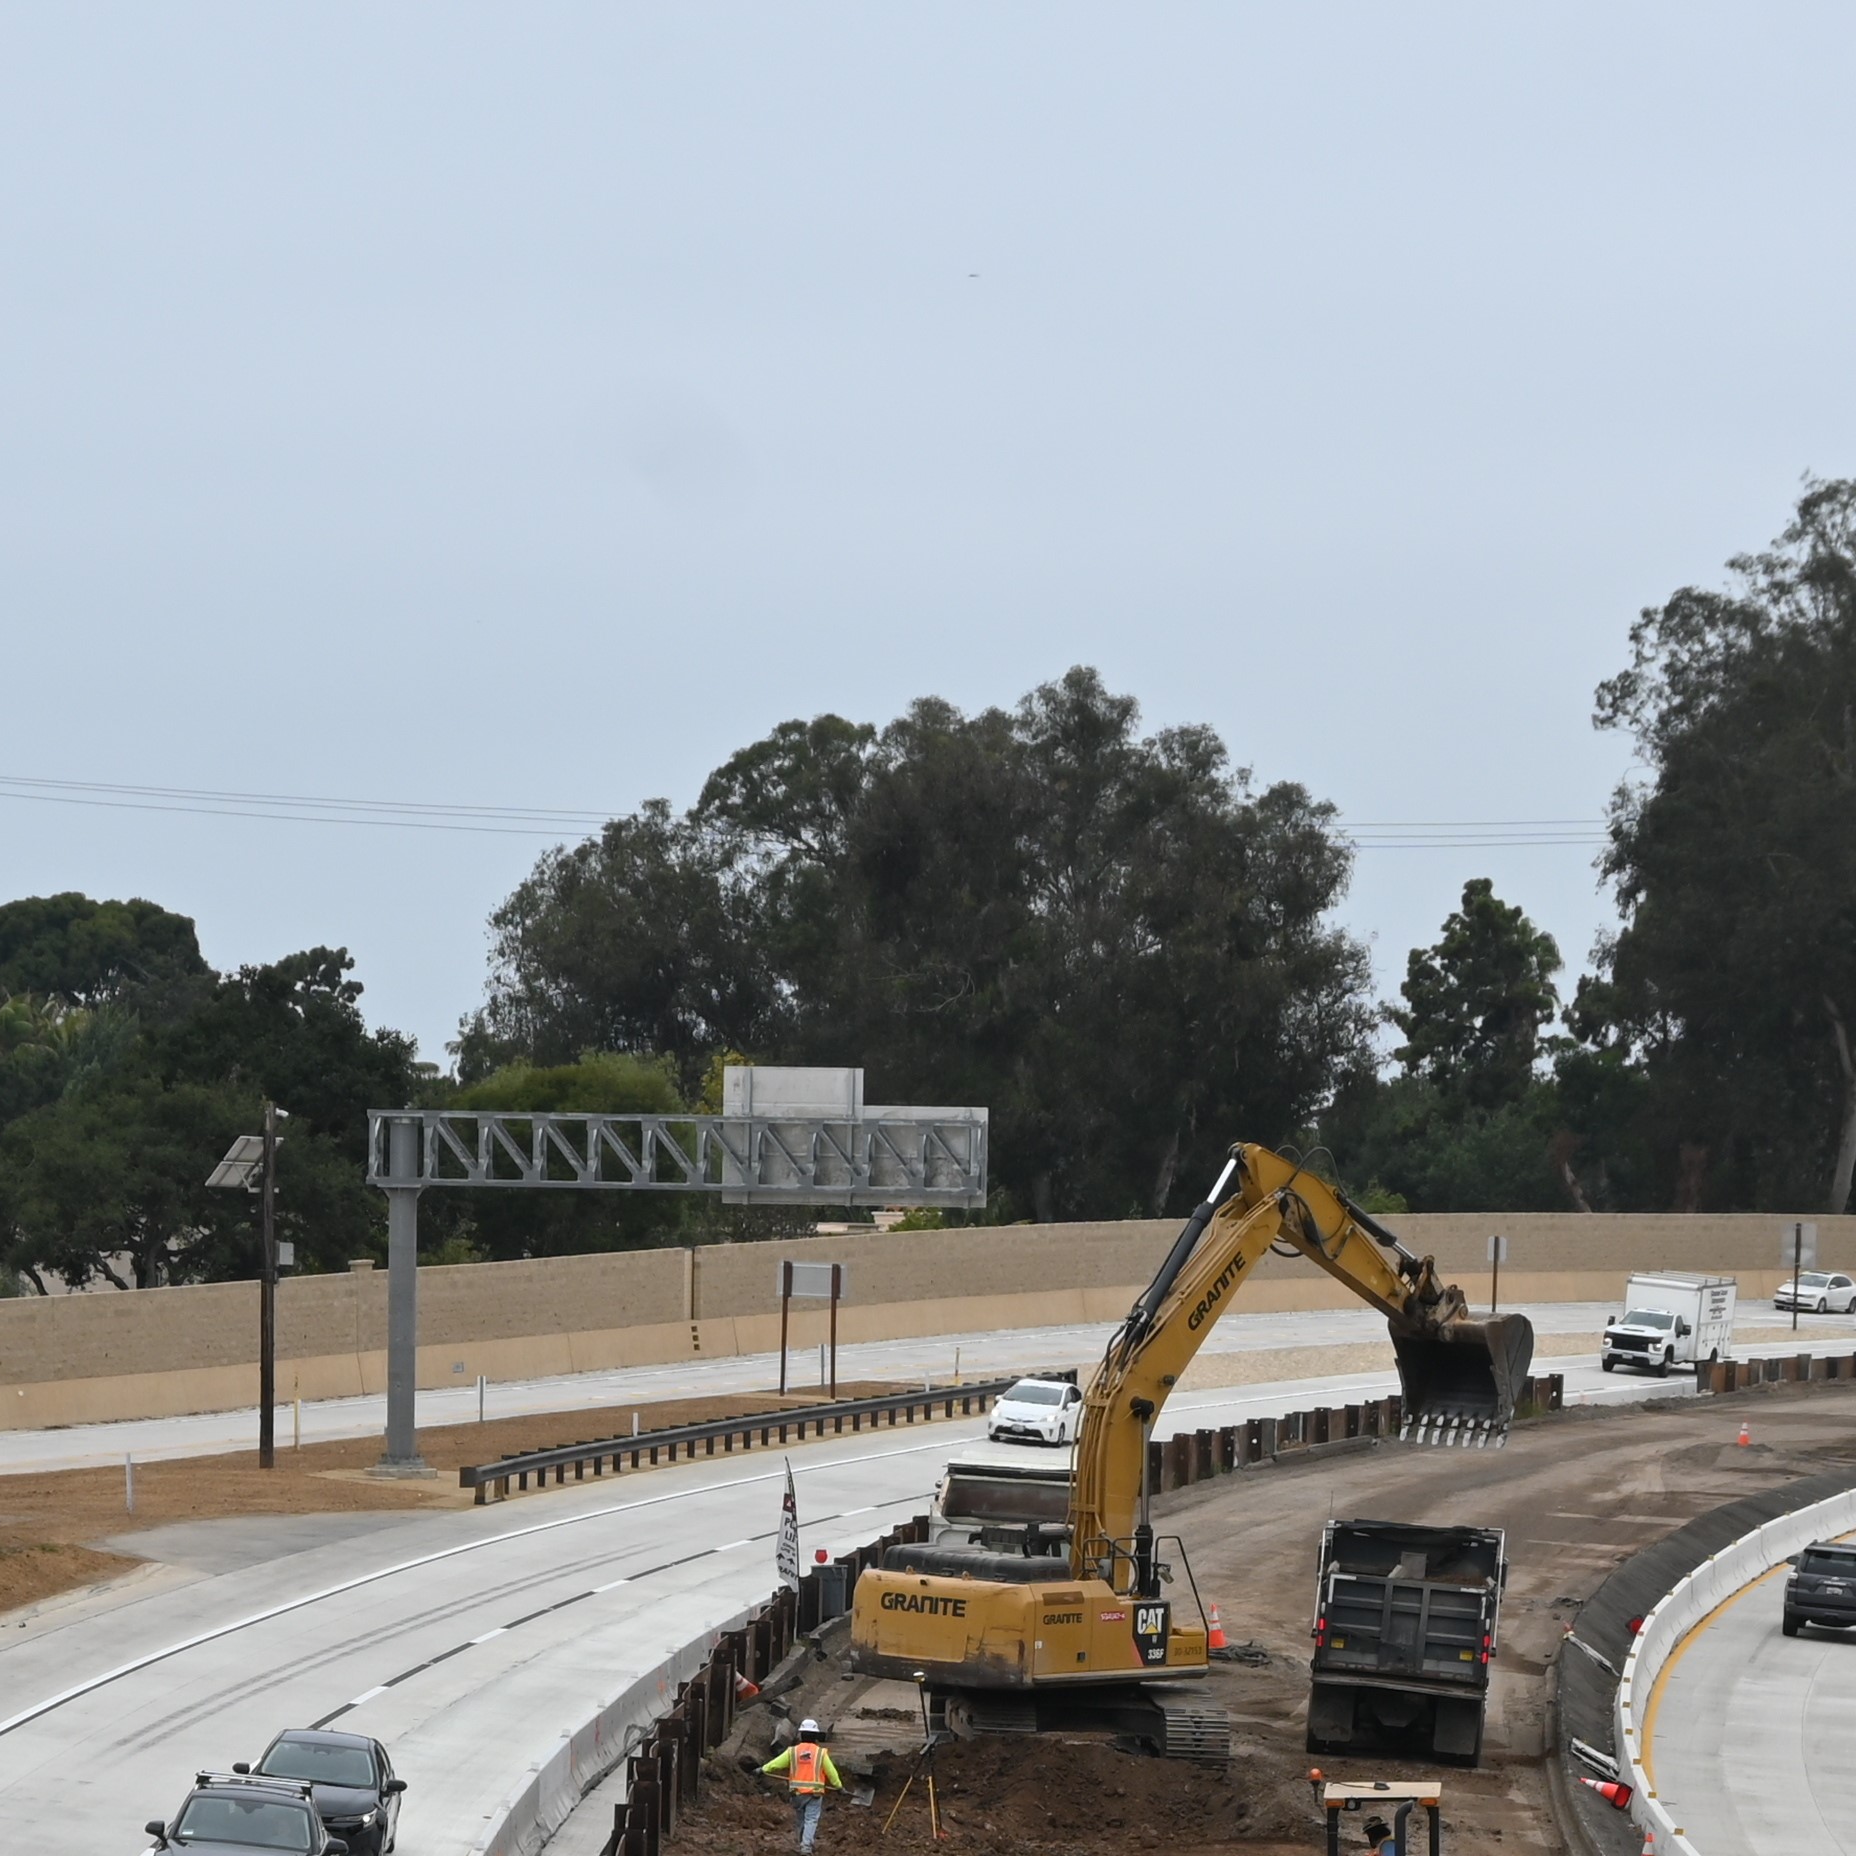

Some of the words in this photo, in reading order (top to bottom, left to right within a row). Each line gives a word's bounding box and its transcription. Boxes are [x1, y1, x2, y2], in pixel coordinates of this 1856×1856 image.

[1188, 1250, 1246, 1331] GRANITE
[881, 1591, 966, 1617] GRANITE
[1043, 1613, 1083, 1625] GRANITE
[1137, 1608, 1164, 1635] CAT
[1147, 1648, 1164, 1660] 336F
